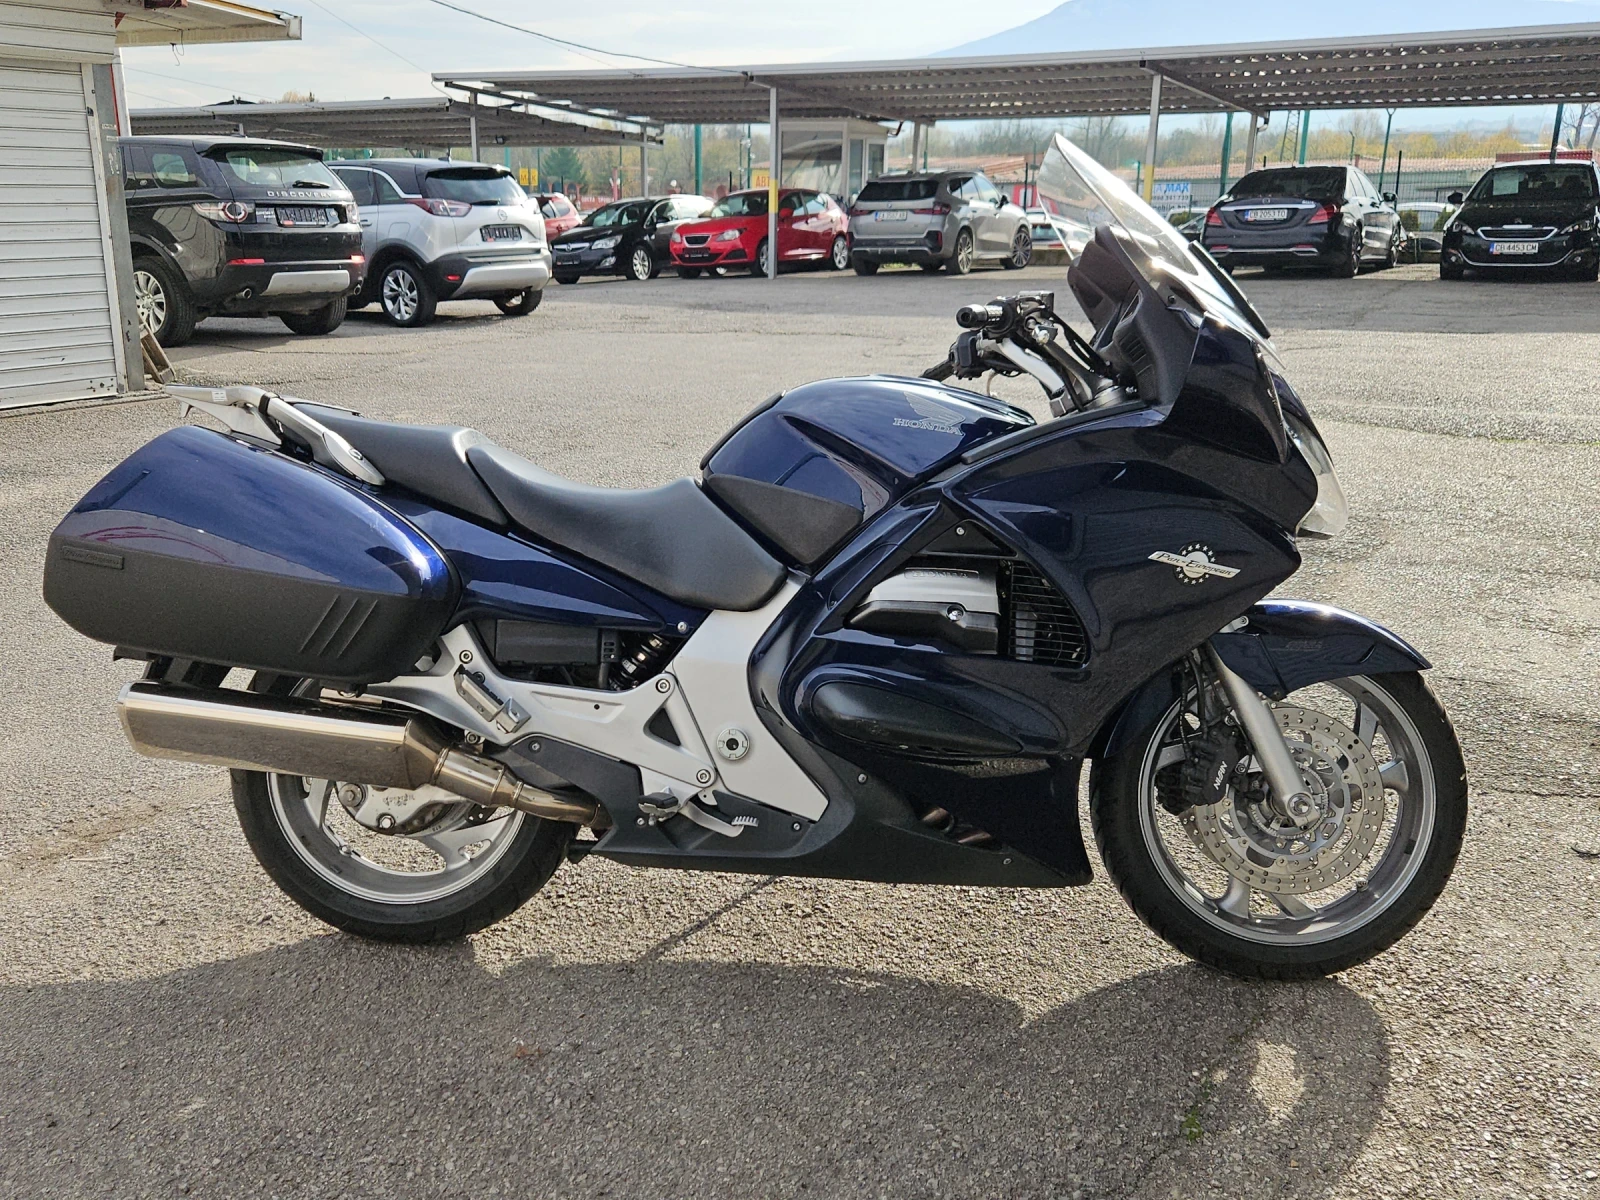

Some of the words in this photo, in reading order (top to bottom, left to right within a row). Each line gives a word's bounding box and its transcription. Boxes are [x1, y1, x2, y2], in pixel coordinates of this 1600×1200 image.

[266, 190, 332, 198] DISCOVERY
[1259, 210, 1276, 218] 2053
[1506, 244, 1525, 252] 4453
[892, 417, 963, 436] HONDA
[1156, 552, 1236, 576] Pan-European
